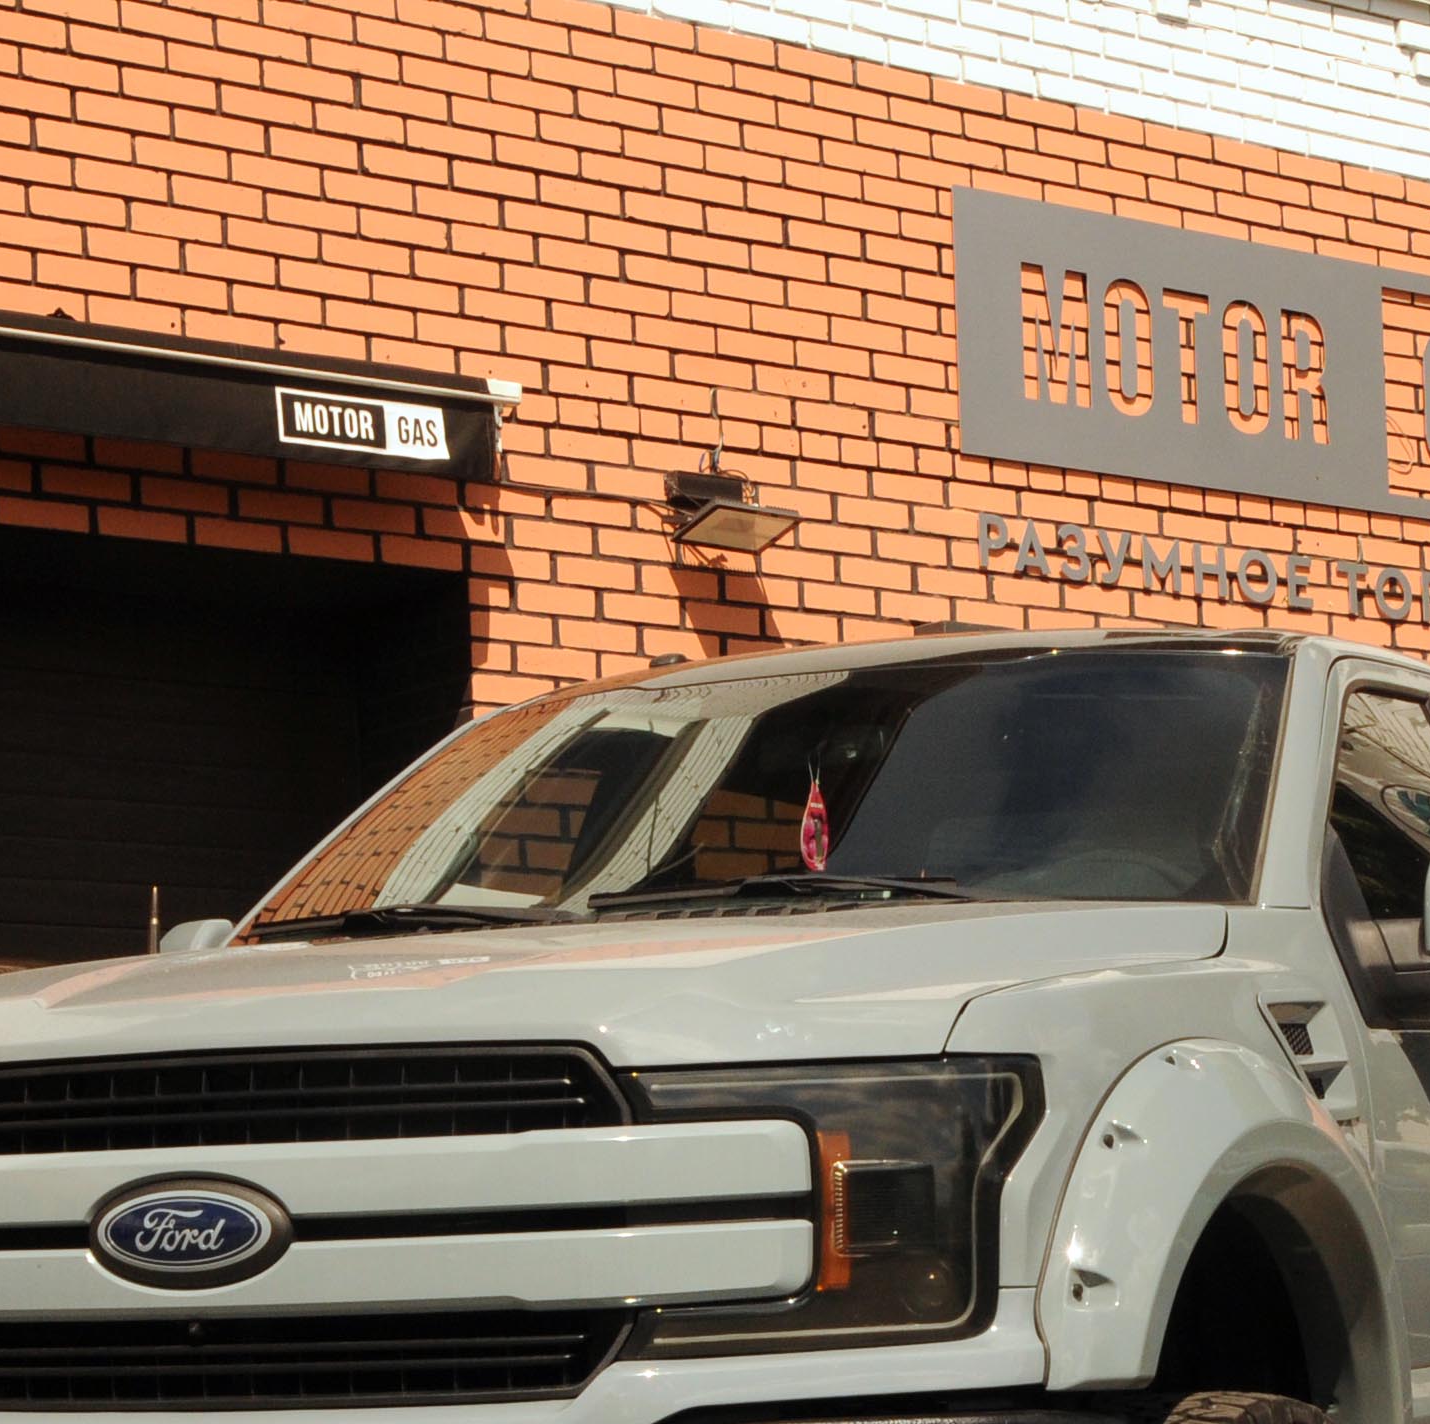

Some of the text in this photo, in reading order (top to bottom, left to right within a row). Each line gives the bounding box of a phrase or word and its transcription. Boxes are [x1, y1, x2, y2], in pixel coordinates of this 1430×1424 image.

[1020, 261, 1330, 445] MOTOR
[293, 401, 439, 448] MOTOR GAS
[977, 511, 1315, 611] РАЗУМНОЕ
[135, 1208, 226, 1252] Ford
